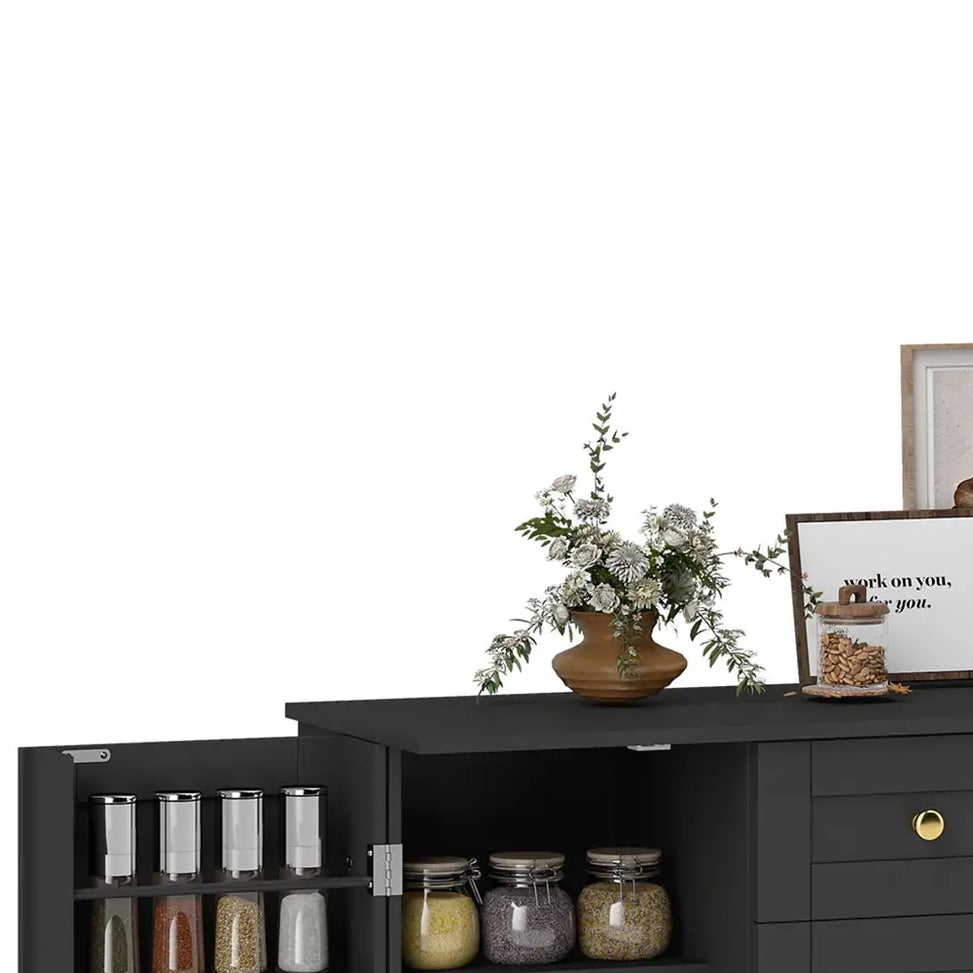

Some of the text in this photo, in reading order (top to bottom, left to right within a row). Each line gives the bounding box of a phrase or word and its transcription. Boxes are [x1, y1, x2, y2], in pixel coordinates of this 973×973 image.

[843, 573, 952, 591] work on you,
[895, 598, 932, 614] you.
